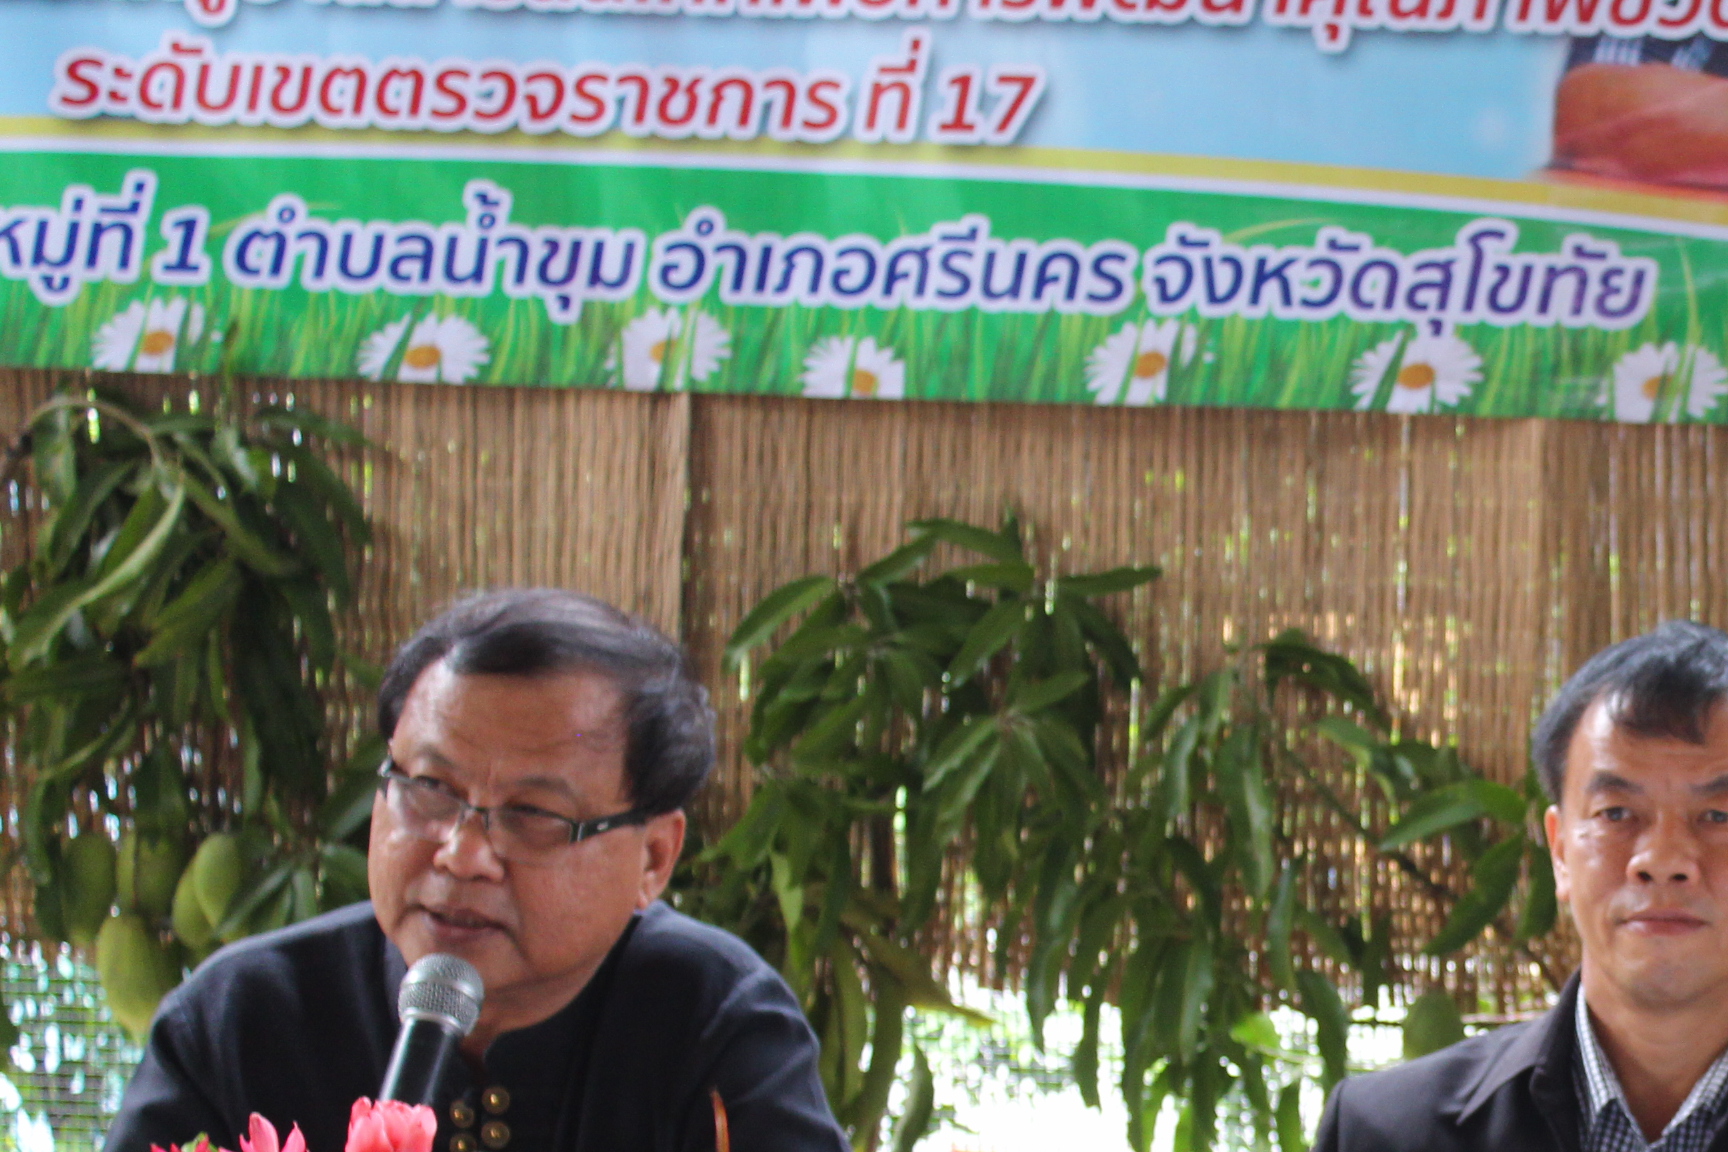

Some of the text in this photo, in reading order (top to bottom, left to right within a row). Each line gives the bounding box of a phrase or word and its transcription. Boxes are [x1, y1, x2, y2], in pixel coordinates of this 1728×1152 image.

[940, 74, 1037, 133] 17
[163, 217, 201, 274] 1
[659, 217, 1127, 304] อำเภอศรีนคร
[1153, 226, 1647, 338] จังหวัดสุโขทัย
